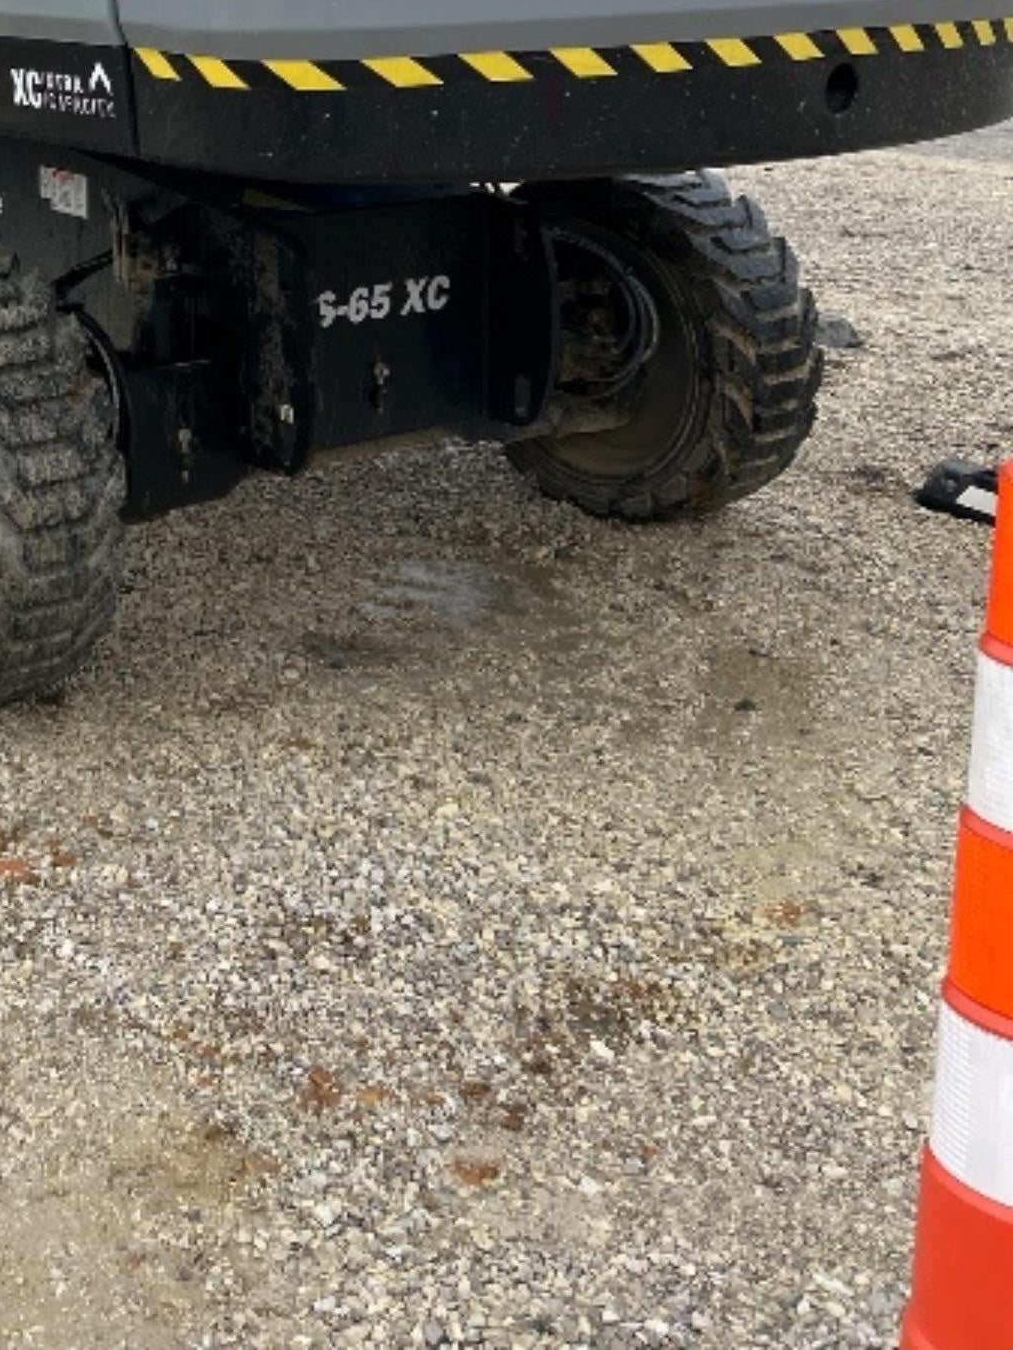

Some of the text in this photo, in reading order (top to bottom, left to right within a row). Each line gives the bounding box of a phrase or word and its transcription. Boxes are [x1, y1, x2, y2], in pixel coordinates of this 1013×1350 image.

[10, 68, 43, 109] XC
[316, 274, 451, 328] S-65 XC
